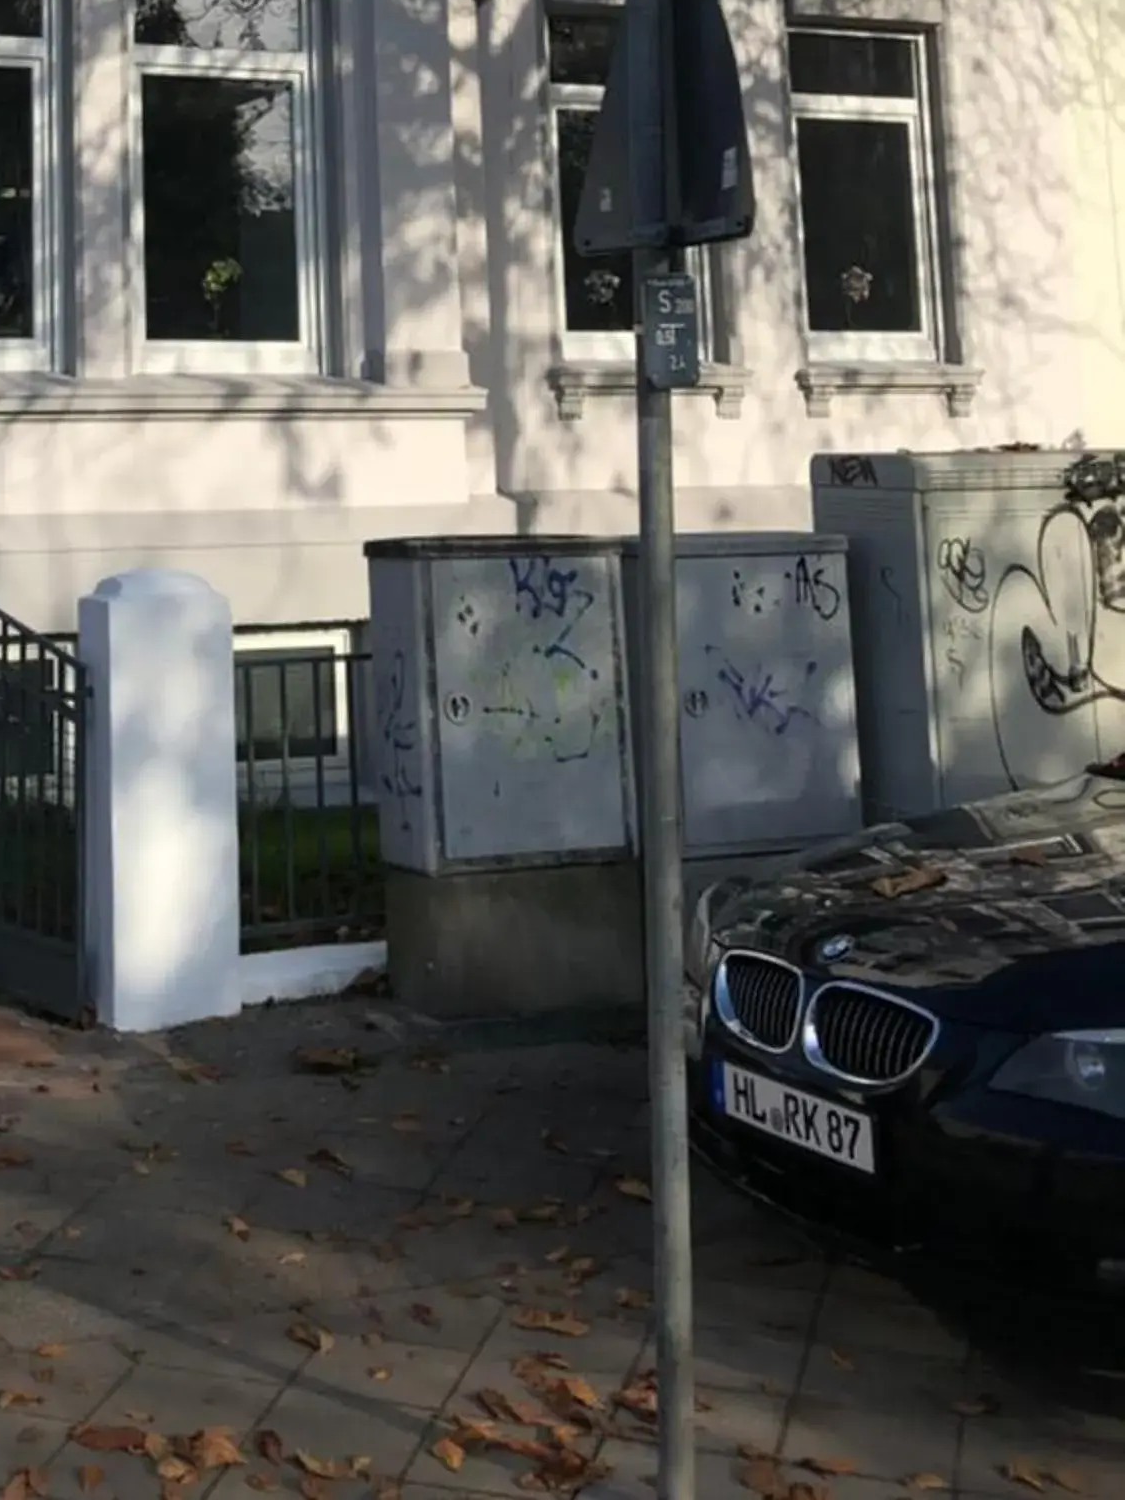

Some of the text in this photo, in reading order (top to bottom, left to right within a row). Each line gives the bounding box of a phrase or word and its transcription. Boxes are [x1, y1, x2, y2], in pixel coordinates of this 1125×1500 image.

[657, 289, 674, 313] S
[733, 1071, 861, 1160] HL RK 87
